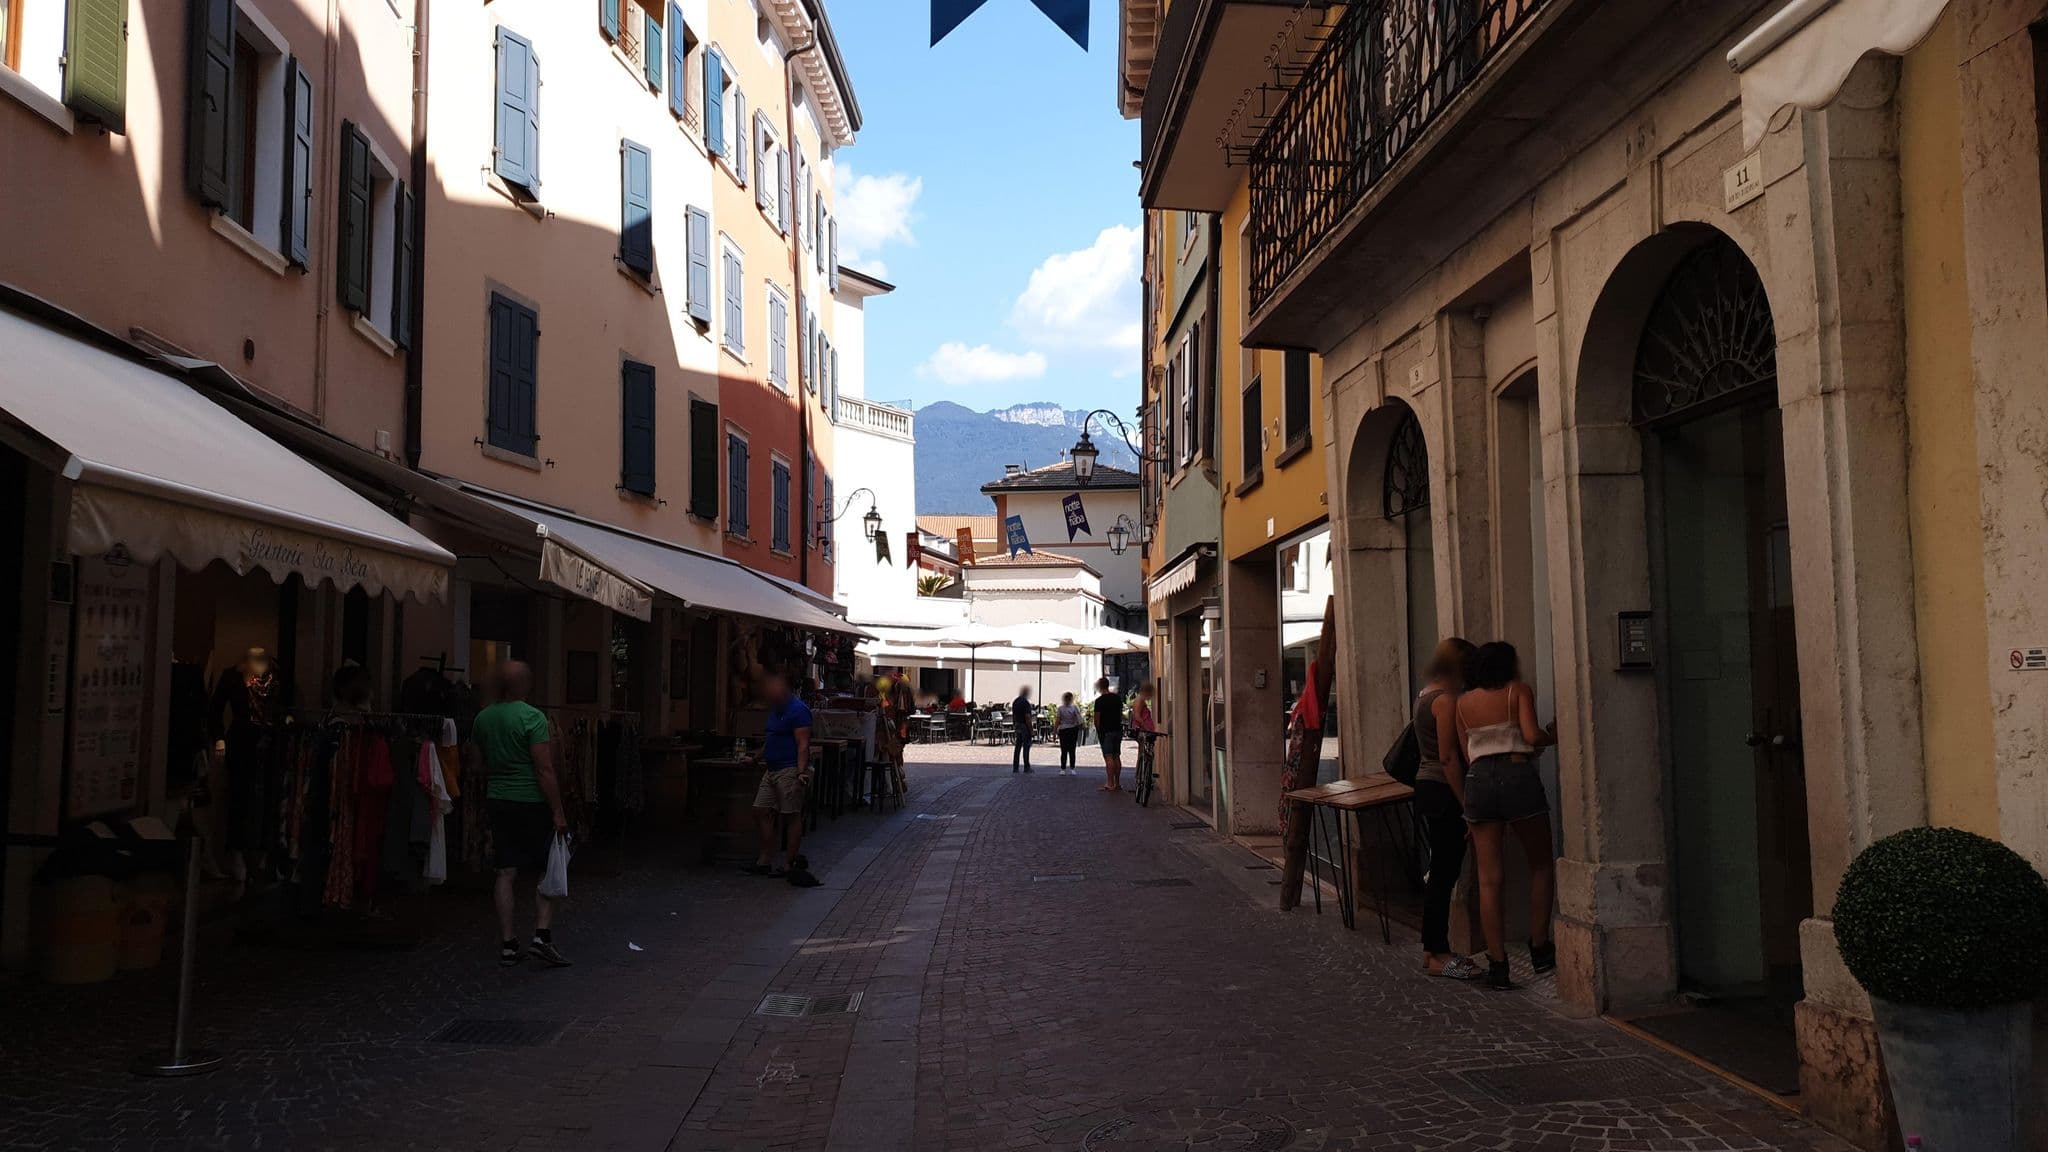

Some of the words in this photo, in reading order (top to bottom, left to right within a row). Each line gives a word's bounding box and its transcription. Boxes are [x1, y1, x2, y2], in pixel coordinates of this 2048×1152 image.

[1736, 166, 1749, 187] 11
[1064, 501, 1081, 513] notte
[1069, 514, 1085, 527] fiaba
